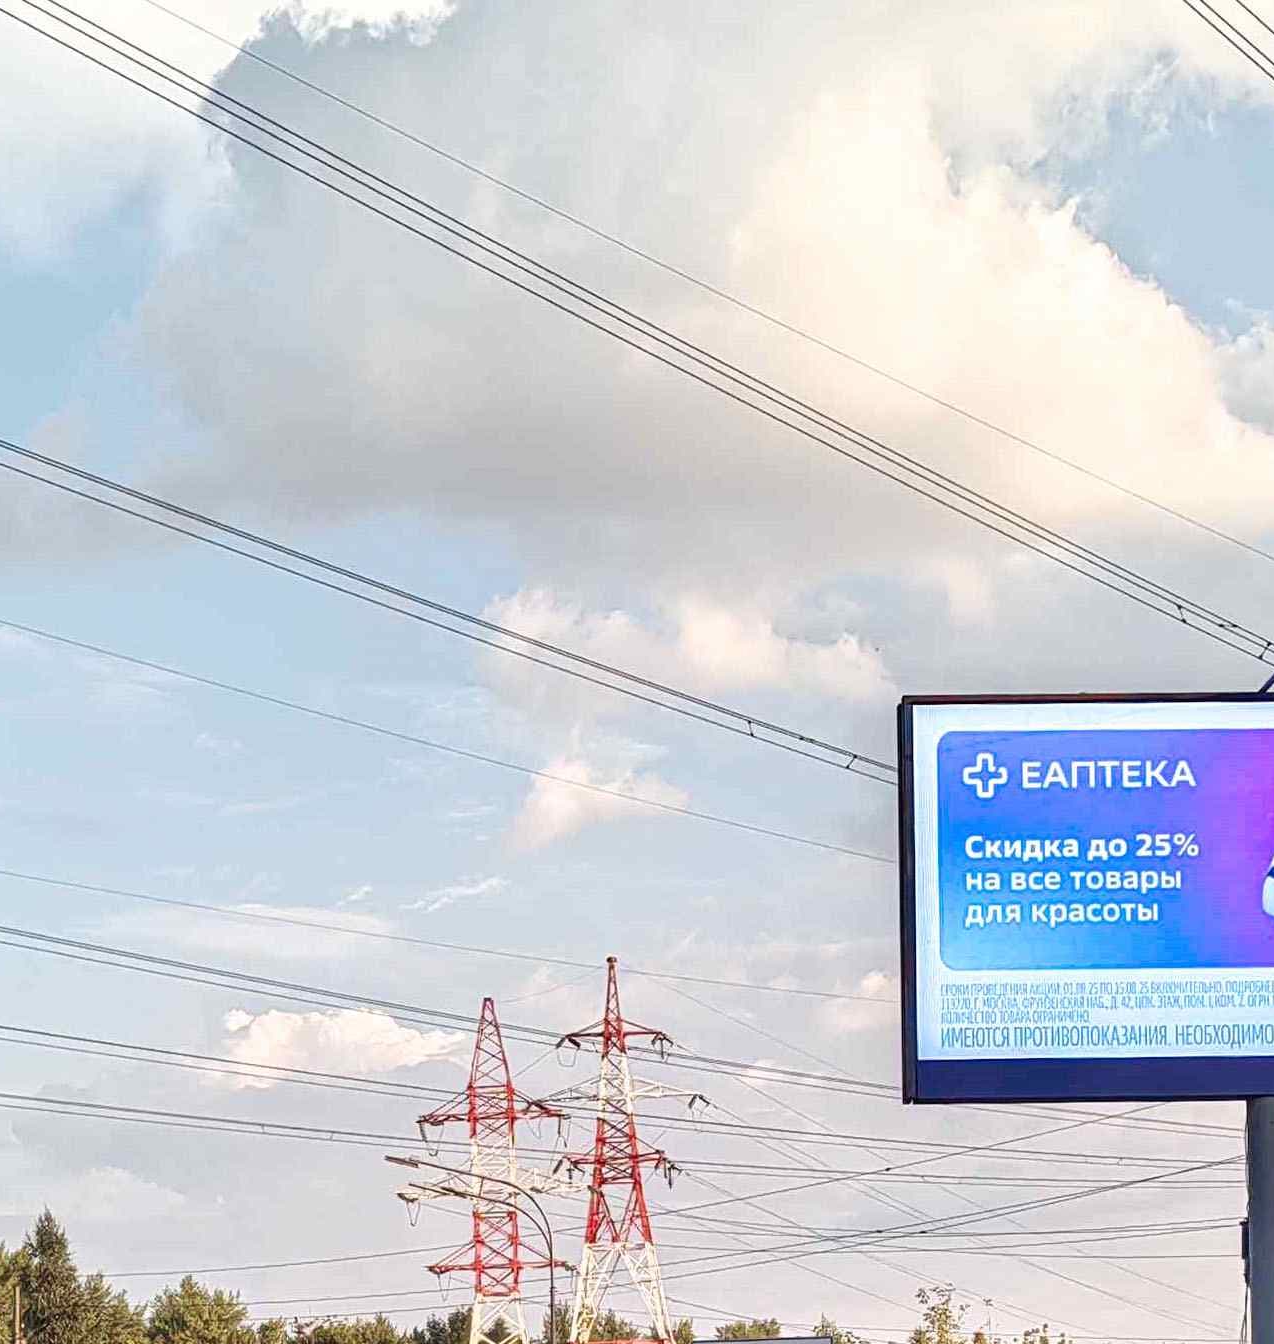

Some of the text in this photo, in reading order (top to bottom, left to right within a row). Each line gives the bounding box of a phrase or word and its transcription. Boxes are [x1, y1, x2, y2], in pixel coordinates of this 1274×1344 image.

[1021, 760, 1197, 788] ЕАПТЕКА
[964, 833, 1200, 862] Скидка до 25%
[965, 869, 1182, 894] на все товары
[965, 903, 1159, 928] для красоты
[941, 1026, 1010, 1048] ИМЕЮТСЯ
[1175, 1023, 1274, 1048] НЕОБХОДИМО
